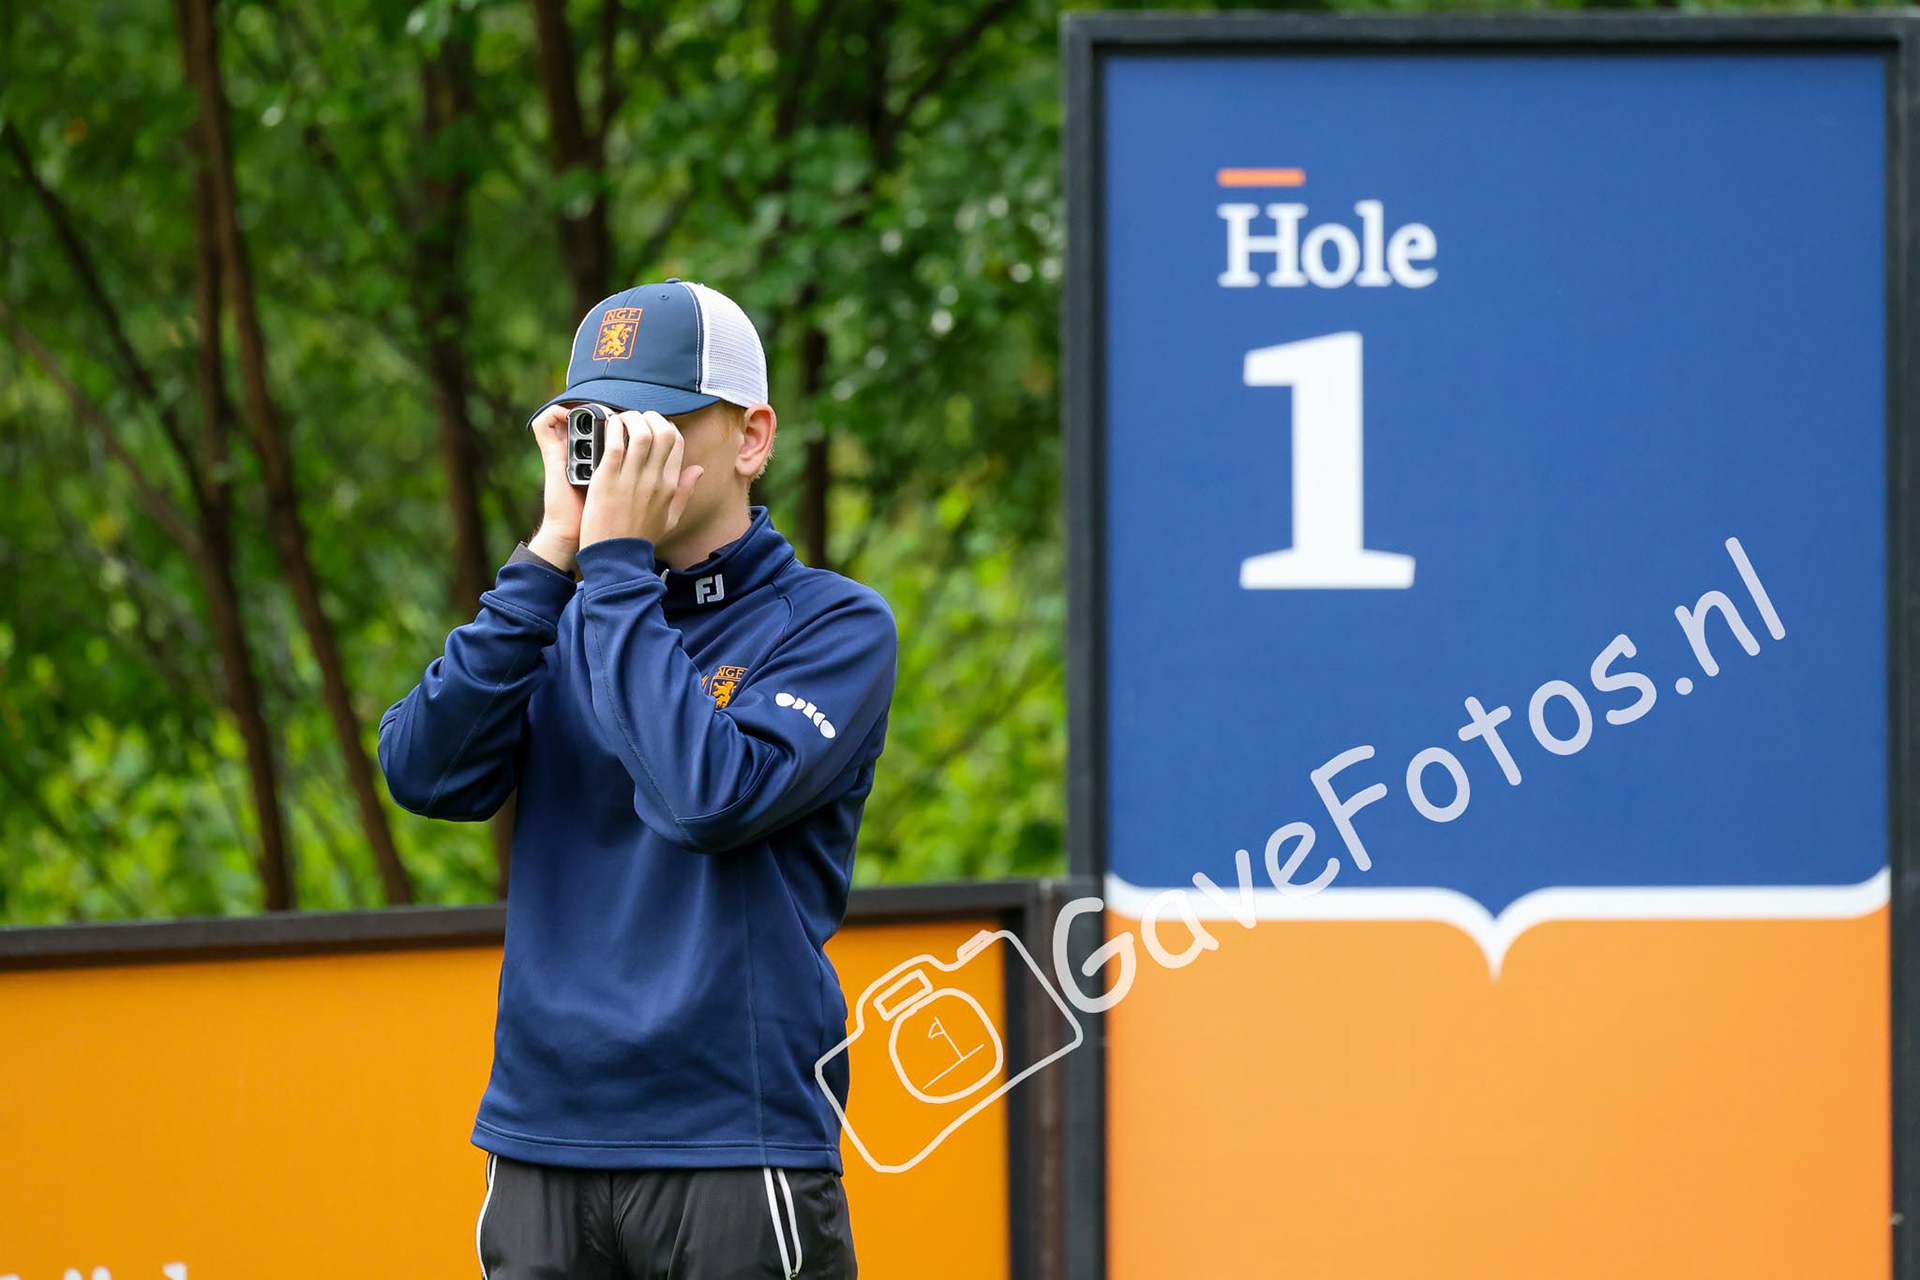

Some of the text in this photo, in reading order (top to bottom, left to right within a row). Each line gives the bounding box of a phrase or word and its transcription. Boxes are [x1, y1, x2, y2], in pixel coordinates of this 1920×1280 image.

[1217, 199, 1438, 289] Hole
[606, 309, 638, 321] NGF
[1239, 331, 1416, 590] 1
[695, 573, 725, 605] FJ
[716, 667, 745, 679] NGF
